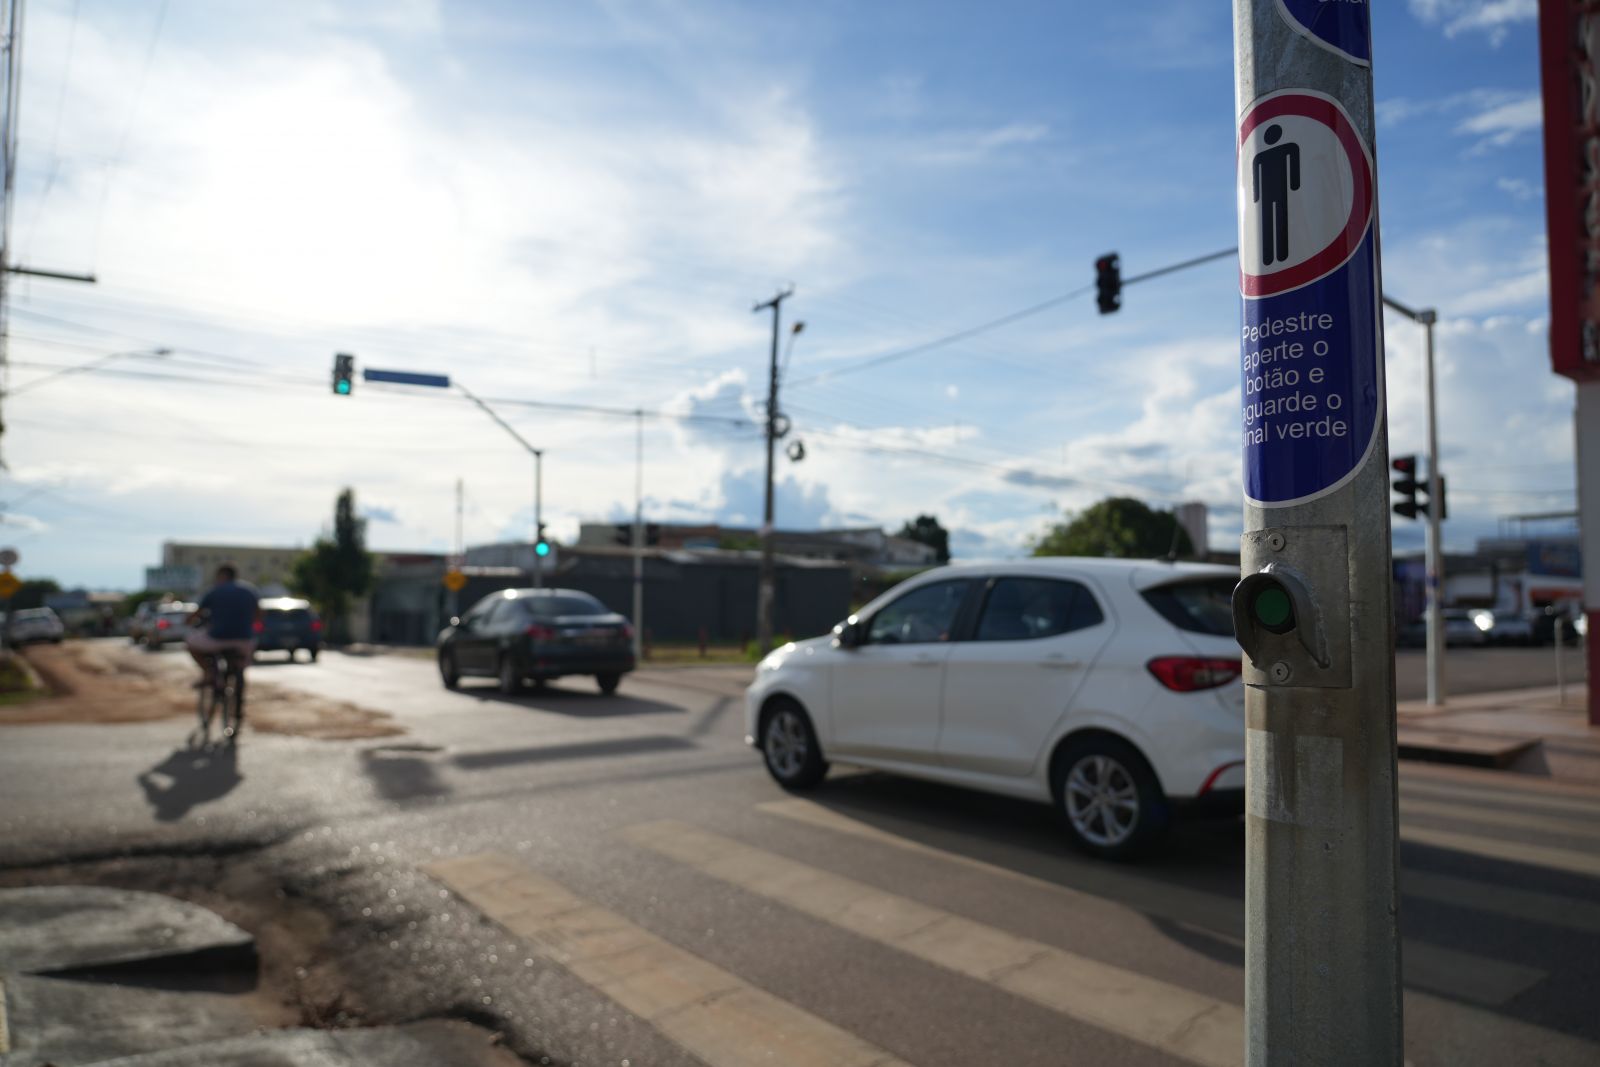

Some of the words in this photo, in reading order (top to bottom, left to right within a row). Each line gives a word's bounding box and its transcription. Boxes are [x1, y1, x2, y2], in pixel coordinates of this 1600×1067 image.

[1242, 312, 1333, 346] Pedestre
[1243, 341, 1304, 373] aperte
[1313, 340, 1329, 356] o
[1246, 368, 1300, 395] botão
[1309, 367, 1324, 383] e
[1326, 394, 1342, 410] o
[1242, 421, 1268, 448] inal
[1276, 416, 1347, 440] verde
